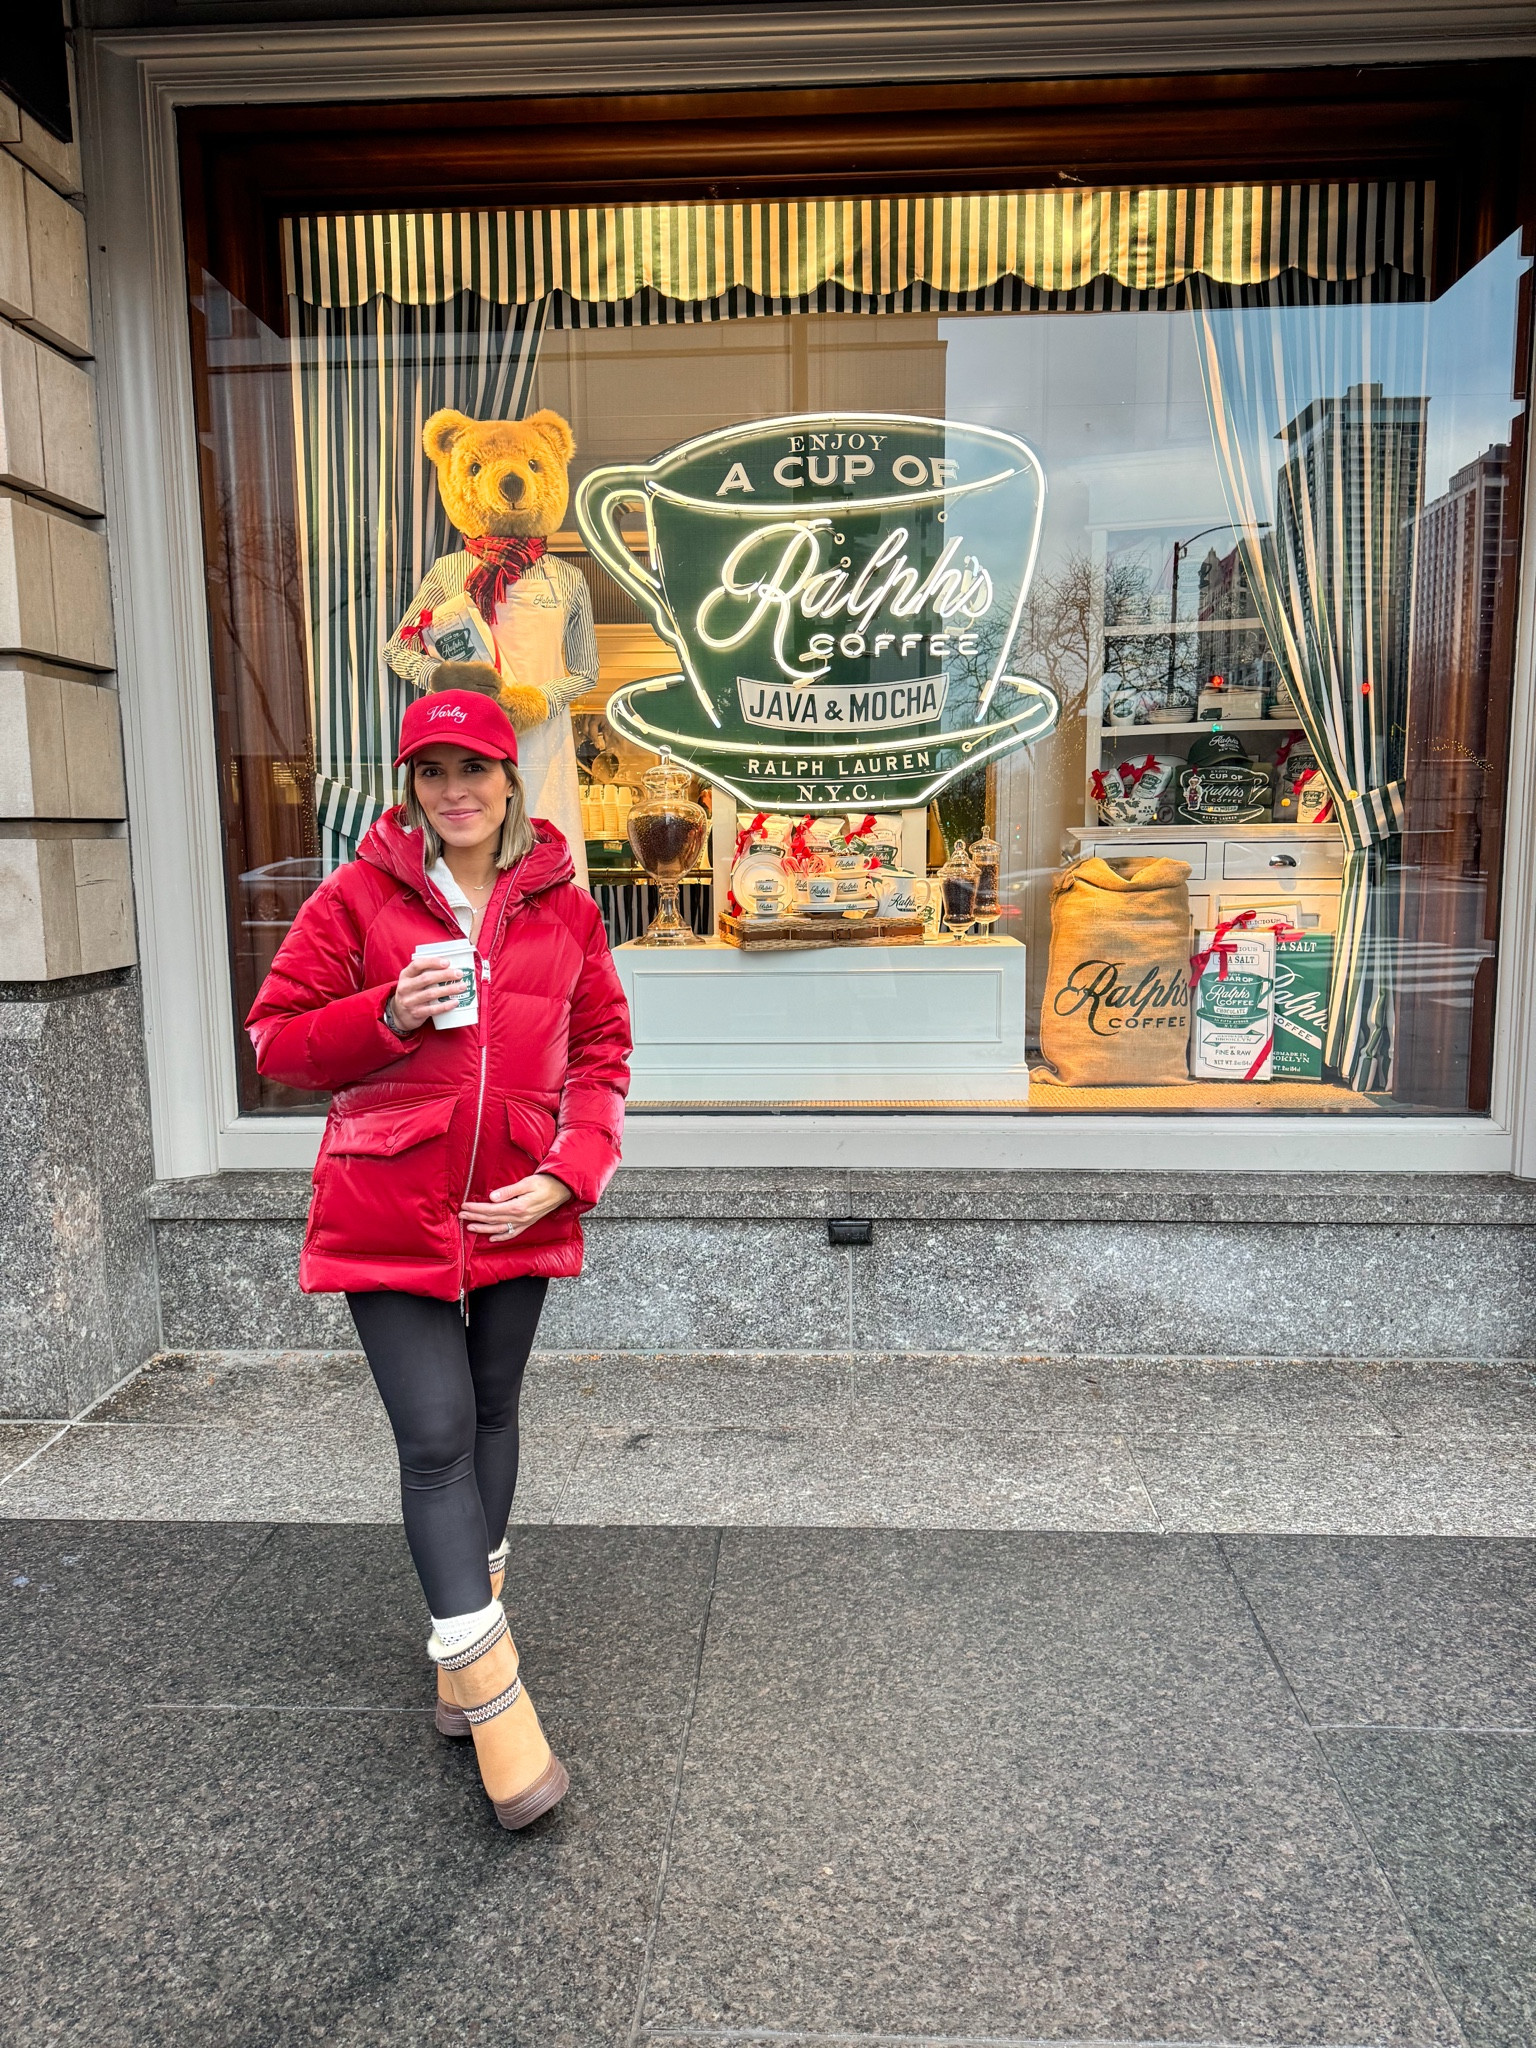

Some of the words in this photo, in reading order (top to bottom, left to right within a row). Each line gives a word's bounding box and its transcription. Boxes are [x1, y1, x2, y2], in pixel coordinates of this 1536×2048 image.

[787, 433, 888, 453] ENJOY
[716, 461, 756, 496] A
[773, 454, 876, 487] CUP
[892, 456, 961, 488] OF
[696, 519, 994, 679] Ralph's
[808, 633, 979, 657] COFFEE
[427, 704, 468, 724] Varley
[749, 688, 818, 725] JAVA
[824, 704, 845, 722] &
[848, 683, 938, 722] MOCHA
[747, 757, 825, 776] RALPH
[837, 751, 931, 775] LAUREN
[796, 784, 876, 803] N.Y.C.
[1289, 941, 1317, 952] SALT
[1234, 955, 1255, 964] SALT
[1054, 959, 1189, 1037] Ralph's
[1205, 985, 1250, 1007] Ralph's
[1109, 1016, 1187, 1029] COFFEE
